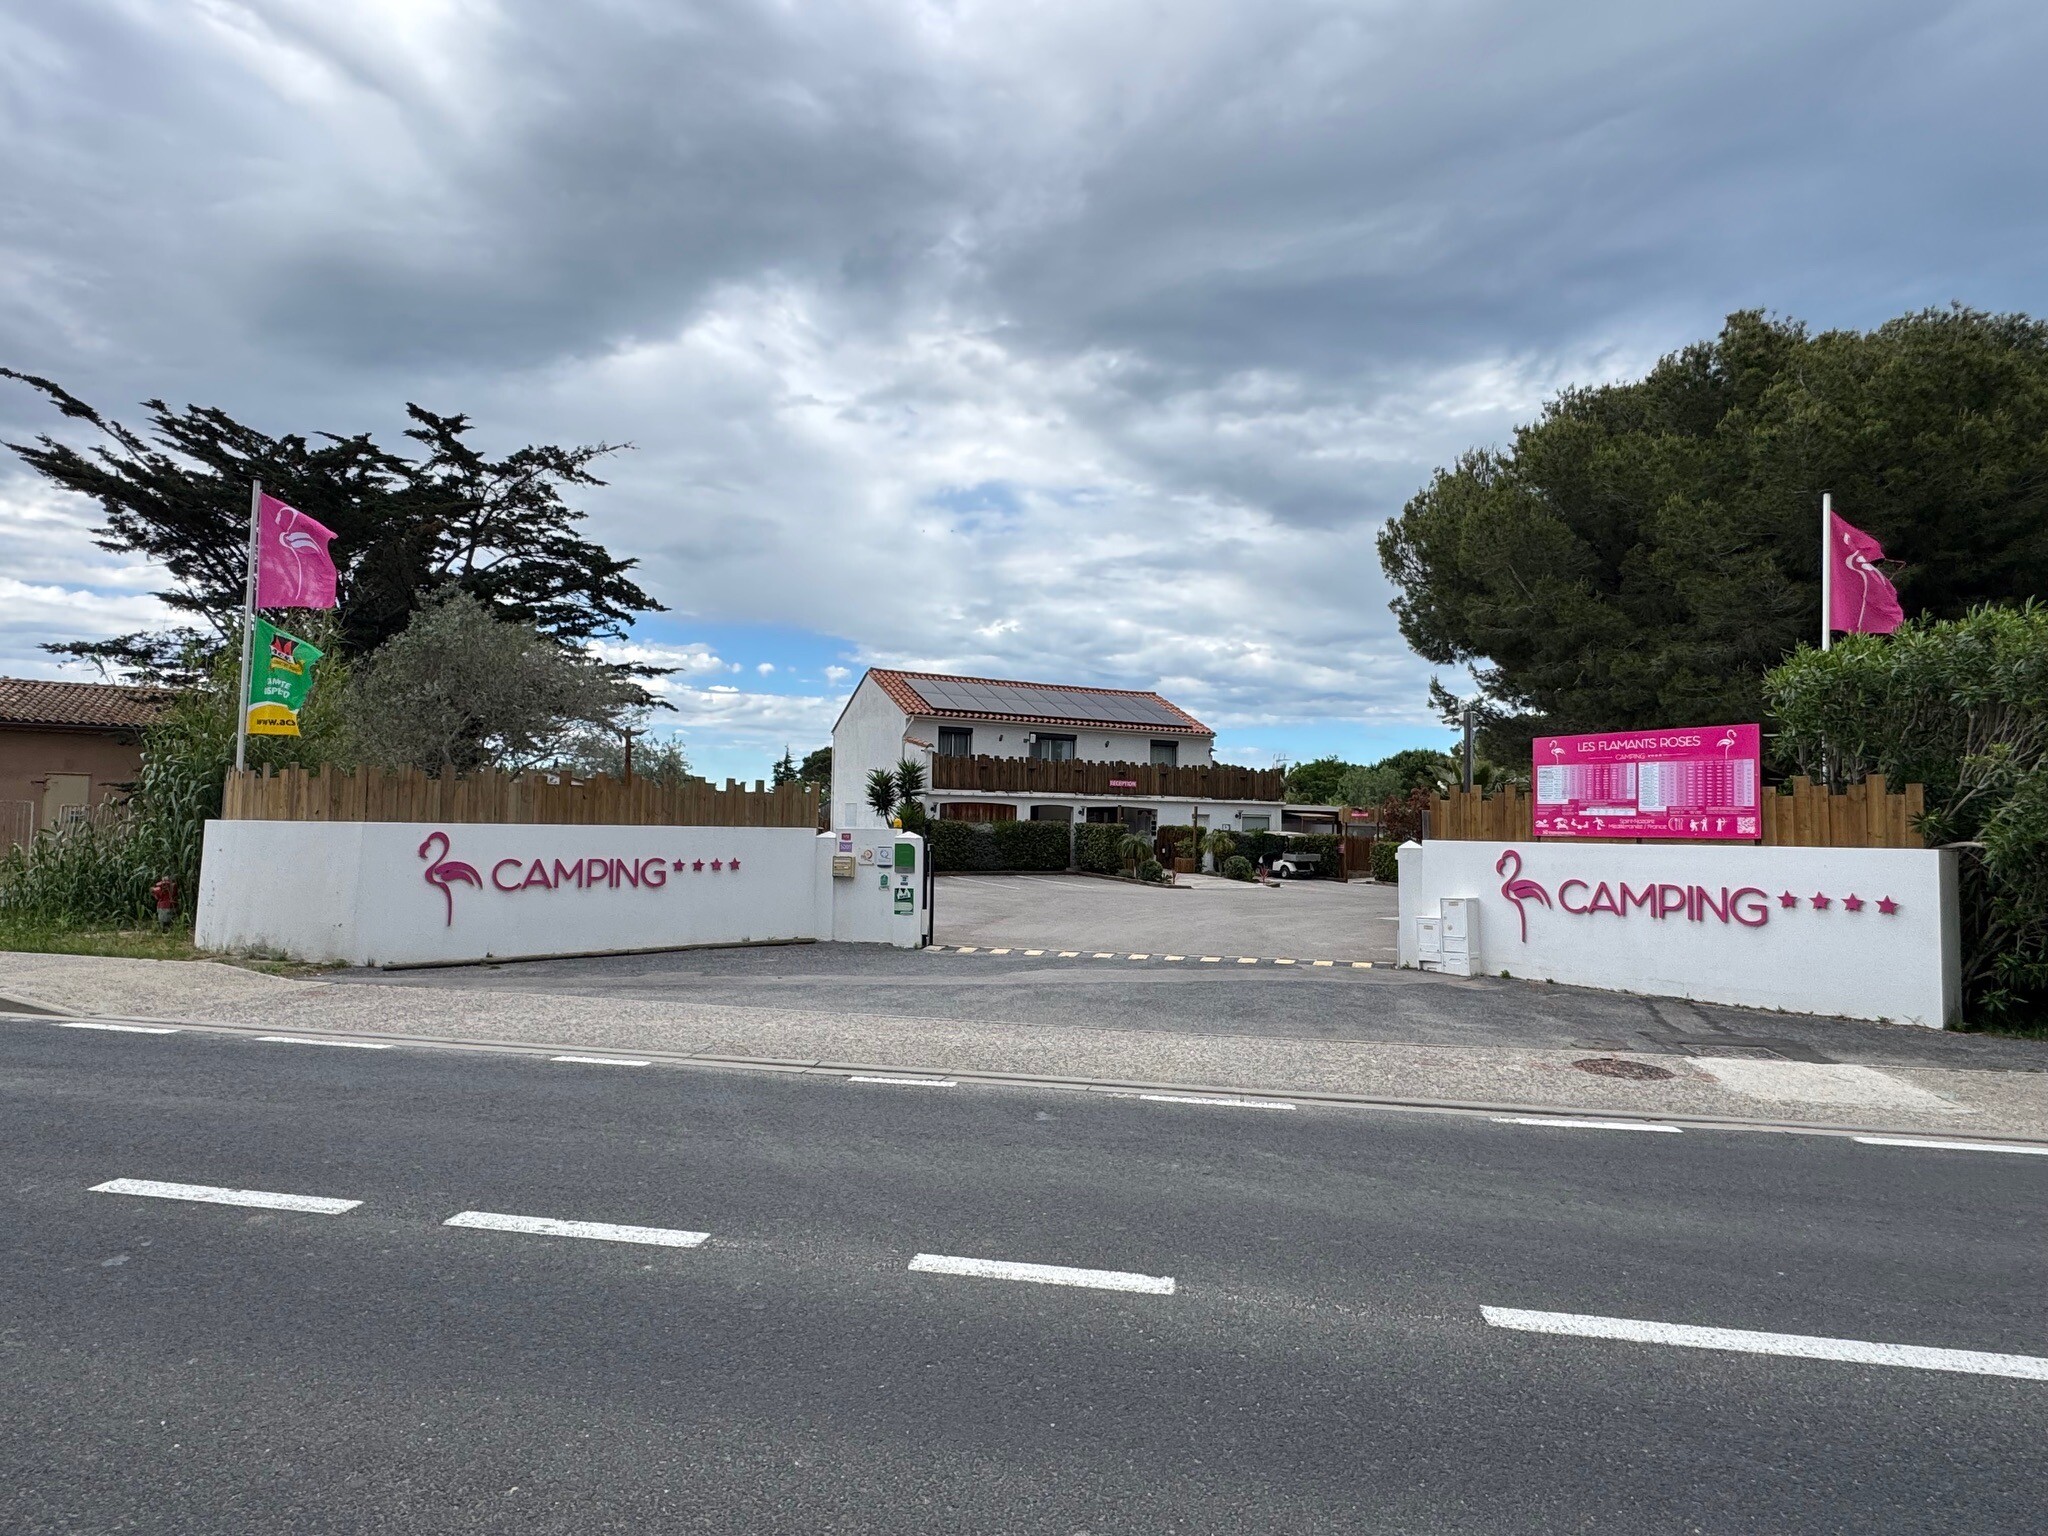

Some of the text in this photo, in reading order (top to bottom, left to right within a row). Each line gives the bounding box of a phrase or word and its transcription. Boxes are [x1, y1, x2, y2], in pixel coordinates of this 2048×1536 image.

[1577, 736, 1701, 753] LES FLAMANTS ROSES
[492, 857, 667, 891] CAMPING
[1558, 879, 1769, 927] CAMPING
